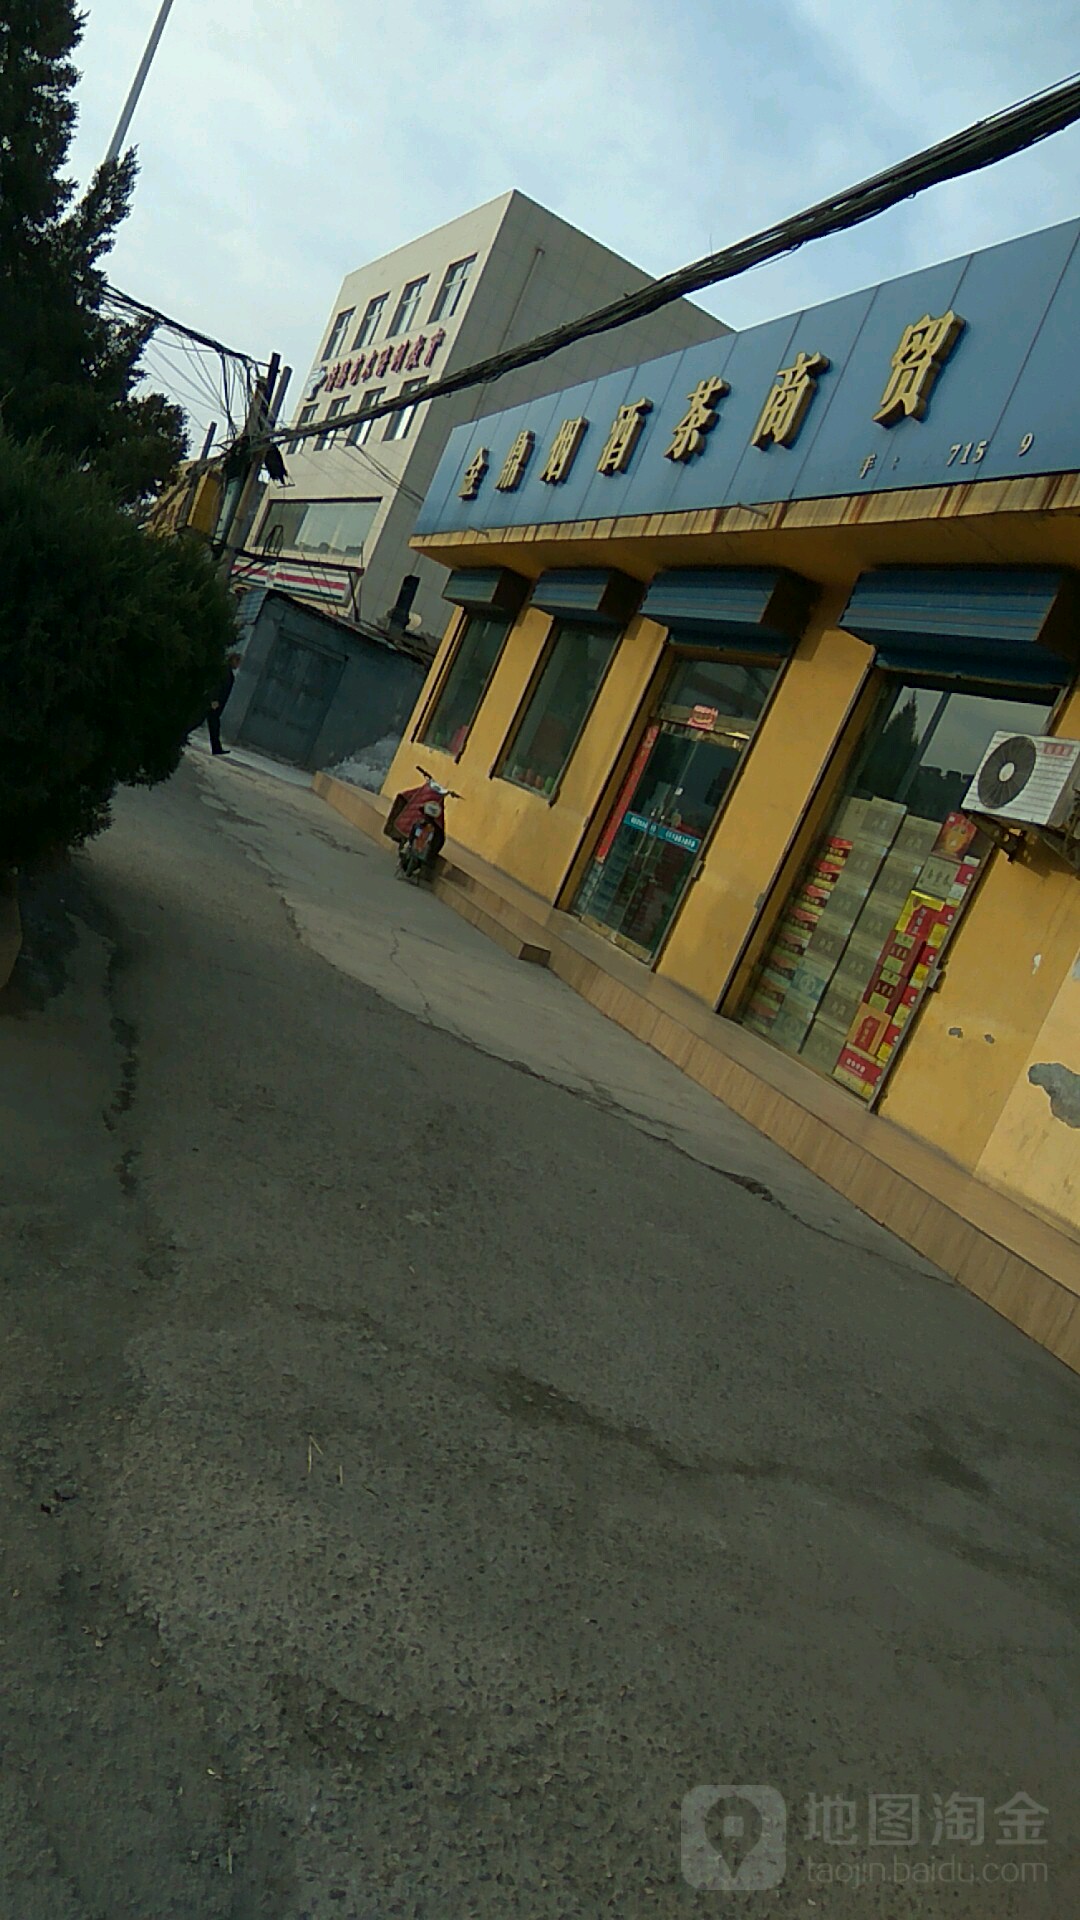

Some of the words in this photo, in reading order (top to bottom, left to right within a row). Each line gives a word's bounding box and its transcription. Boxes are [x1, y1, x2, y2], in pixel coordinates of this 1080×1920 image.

[458, 310, 965, 500] 金鼎烟酒茶商贸
[945, 440, 986, 467] 715
[1017, 432, 1034, 457] 9
